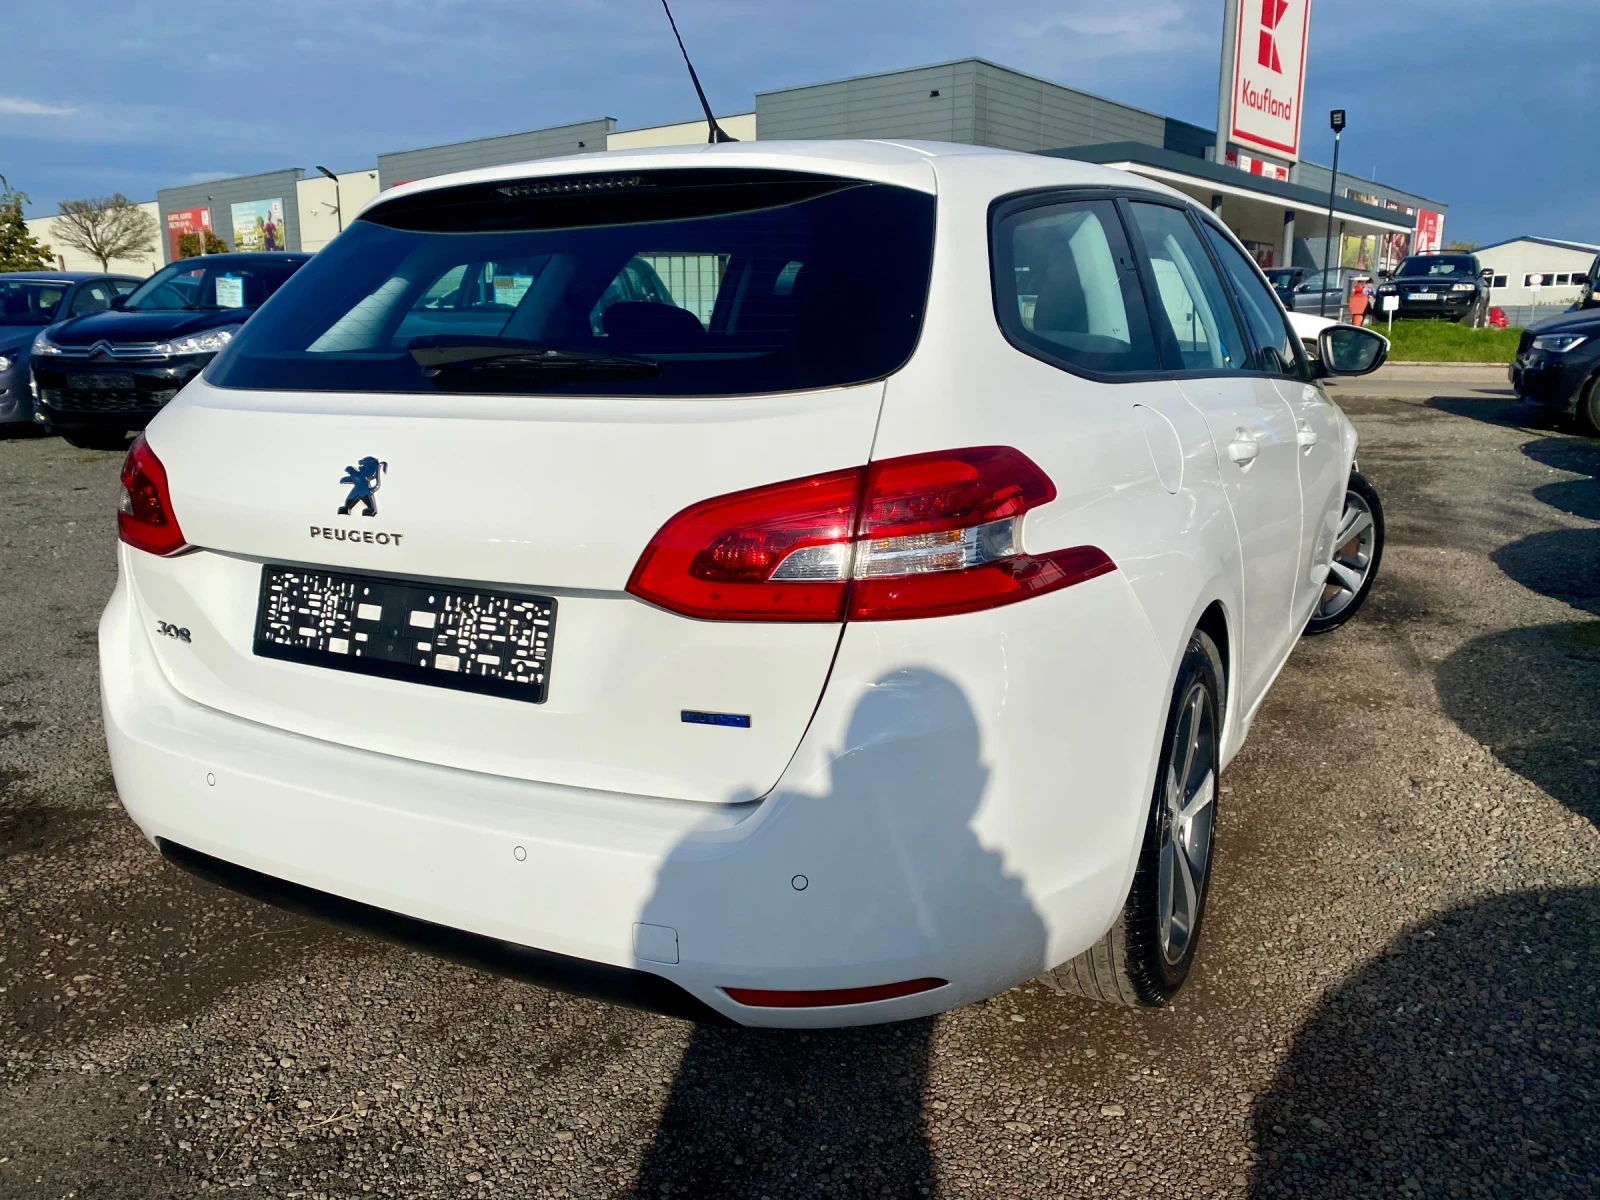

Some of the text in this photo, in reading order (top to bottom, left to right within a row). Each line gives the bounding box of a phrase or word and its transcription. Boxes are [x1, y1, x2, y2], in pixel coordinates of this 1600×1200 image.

[1241, 78, 1292, 121] Kaufland
[310, 526, 403, 546] PEUGEOT
[156, 620, 192, 644] 308
